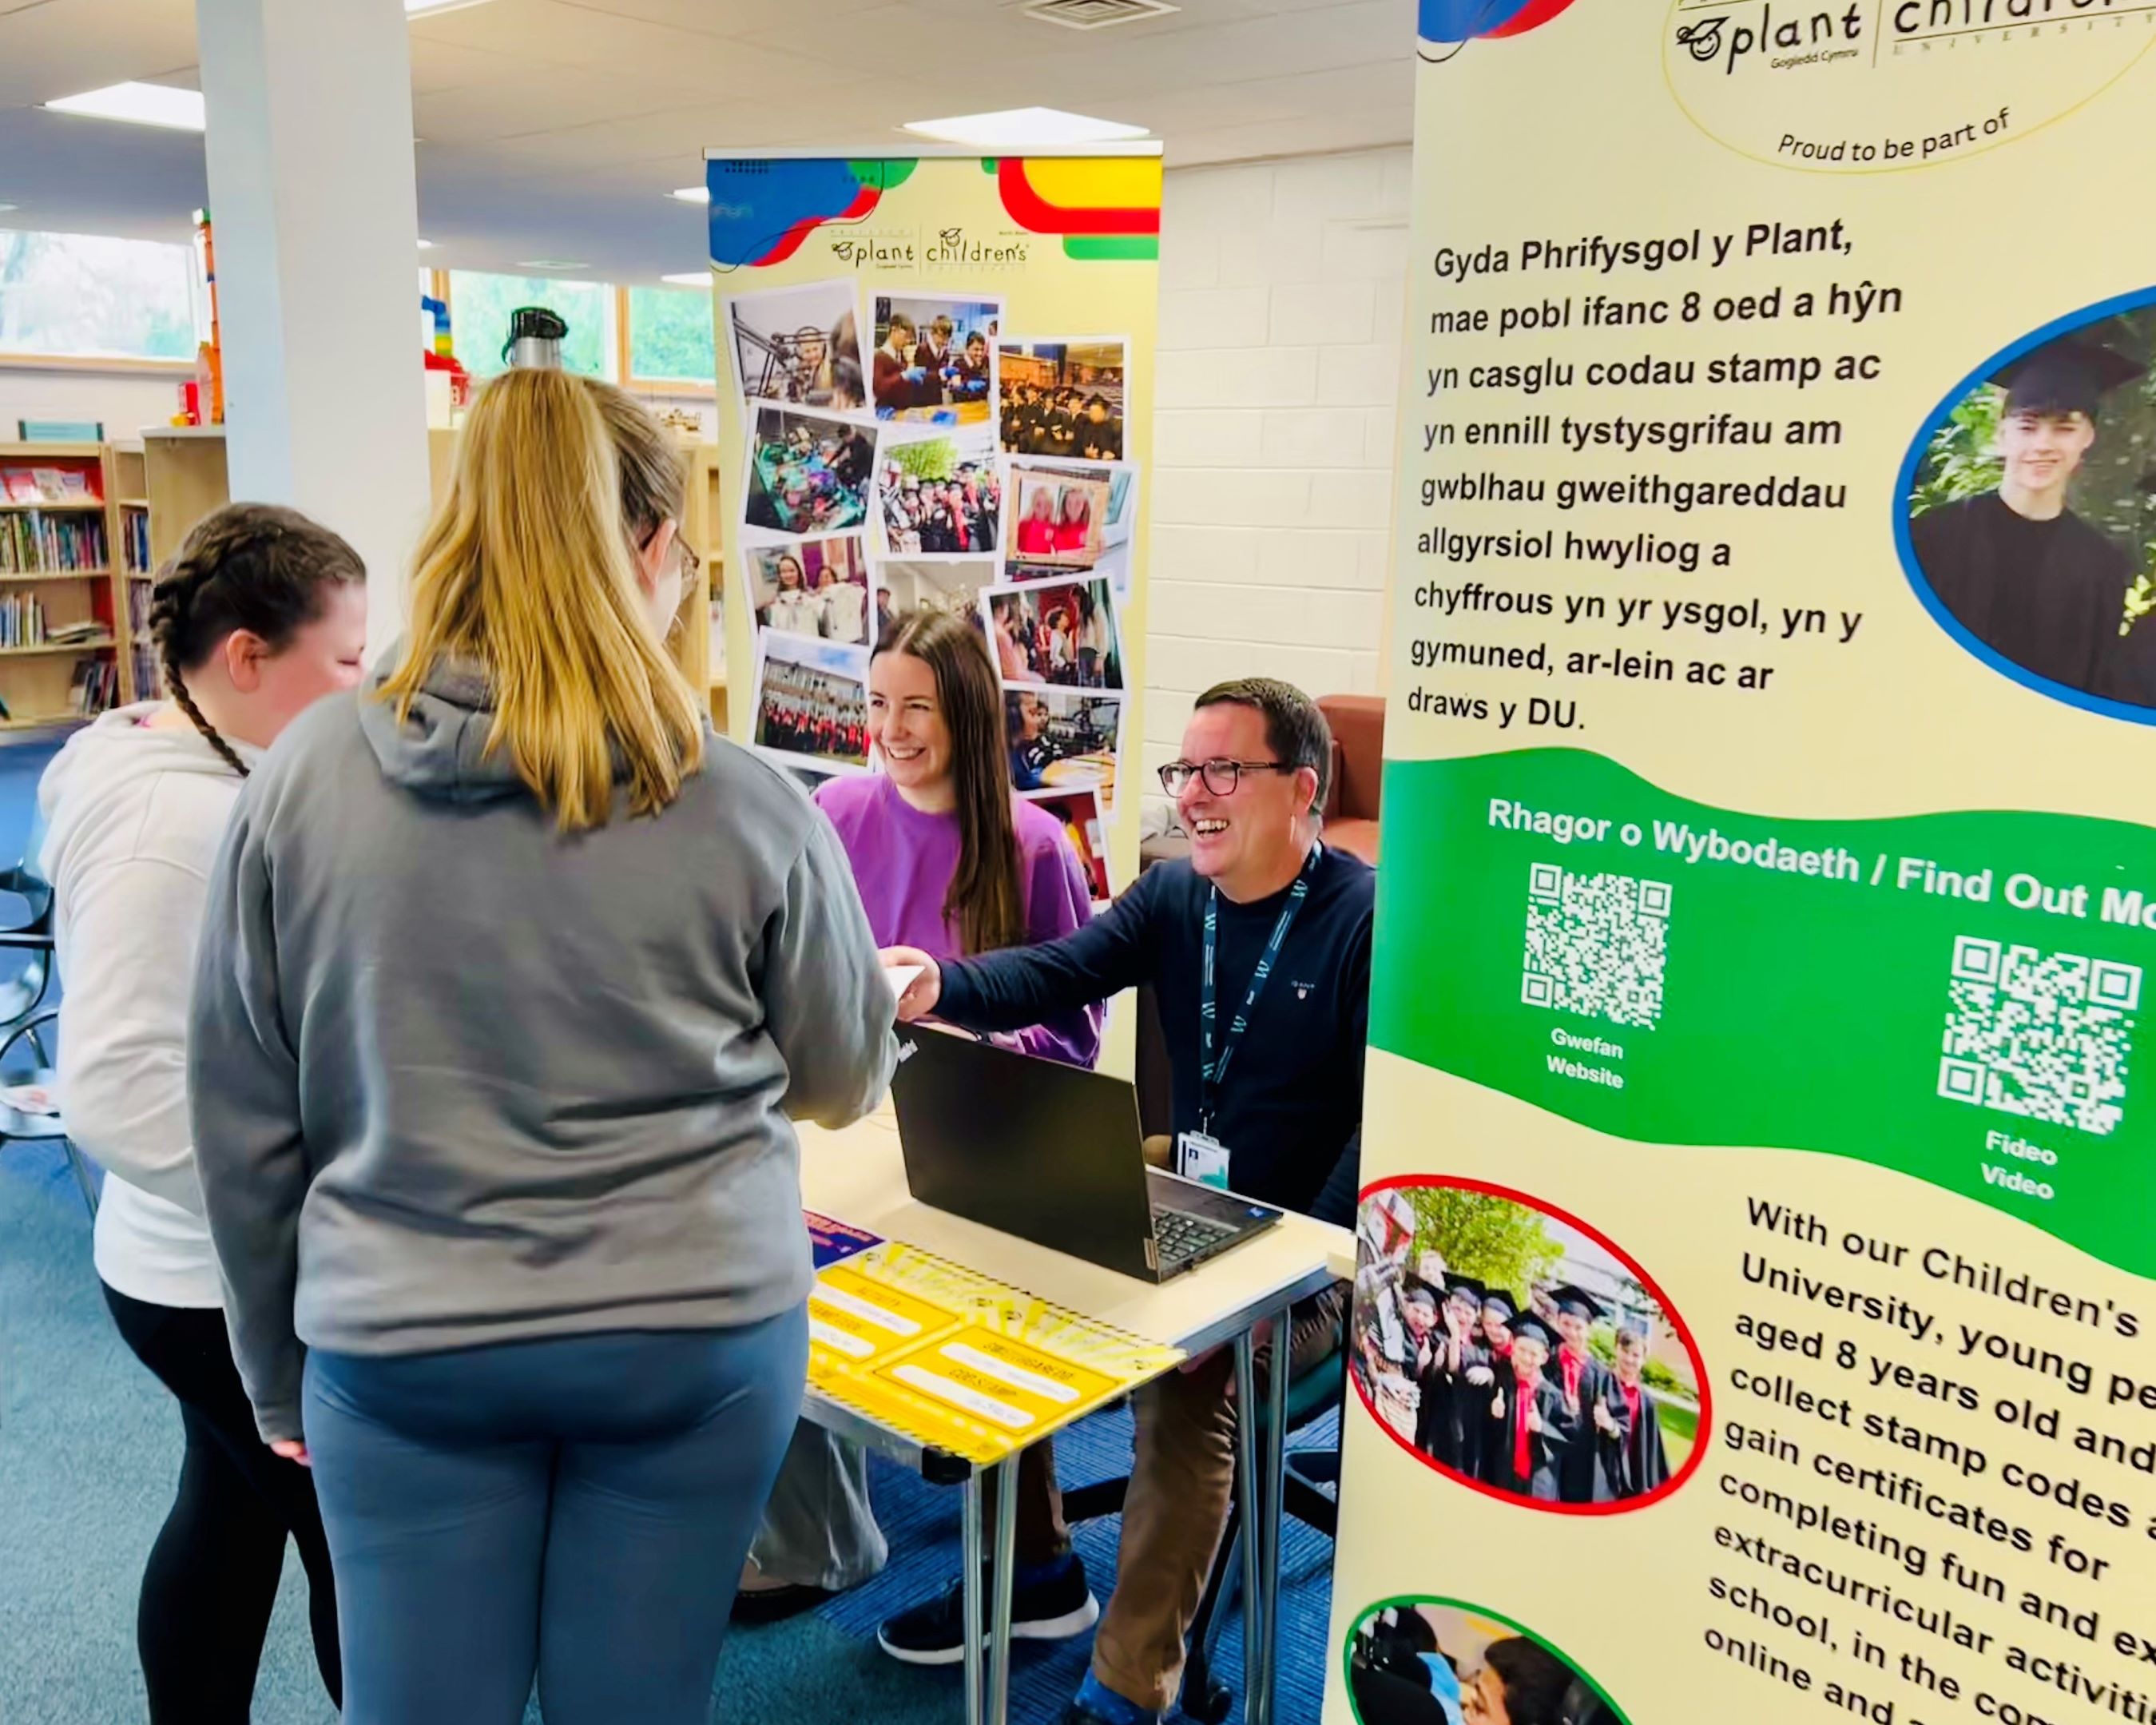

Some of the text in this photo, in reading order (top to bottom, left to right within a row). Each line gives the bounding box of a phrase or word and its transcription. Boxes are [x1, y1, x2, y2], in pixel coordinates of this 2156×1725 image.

[1726, 2, 1861, 75] plant
[1778, 107, 2009, 161] Proud to be part of
[856, 239, 1027, 268] plant children's
[1435, 218, 1852, 284] Gyda Phrifysgol y Plant,
[1431, 280, 1902, 338] mae pobl ifanc 8 oed a hŷn
[1427, 353, 1881, 397] yn casglu codau stamp ac
[1423, 413, 1841, 453] yn ennill tystysgrifau am
[1421, 472, 1846, 513] gwblhau gweithgareddau
[1418, 527, 1731, 573] allgyrsiol hwyliog a
[1415, 580, 1862, 643] chyffrous yn yr ysgol, yn y
[1412, 639, 1774, 690] gymuned, ar-lein ac ar
[1408, 686, 1584, 729] draws y DU.
[1488, 798, 1612, 845] Rhagor
[1620, 823, 1642, 846] o
[1652, 819, 1859, 882] Wybodaeth
[1870, 854, 1887, 886] /
[1897, 857, 1992, 902] Find
[2004, 873, 2089, 918] Out
[1546, 1054, 1625, 1089] Website
[1550, 1027, 1624, 1059] Gwefan
[1985, 1129, 2059, 1166] Fideo
[1980, 1162, 2055, 1200] Video
[1748, 1196, 2138, 1337] With our Children's
[1742, 1252, 1943, 1344] University,
[1958, 1325, 2093, 1395] young
[1735, 1314, 2156, 1474] aged 8 years old and
[1730, 1369, 1852, 1428] collect
[1863, 1413, 1987, 1477] stamp
[2002, 1463, 2130, 1528] codes
[1725, 1421, 2110, 1580] gain certificates for
[1720, 1474, 1927, 1576] completing
[1941, 1552, 2005, 1603] fun
[2019, 1592, 2098, 1642] and
[1714, 1526, 1994, 1654] extracurricular
[1709, 1577, 1837, 1651] school,
[1853, 1631, 1885, 1669] in
[1900, 1653, 1960, 1700] the
[1705, 1629, 1894, 1725] online and
